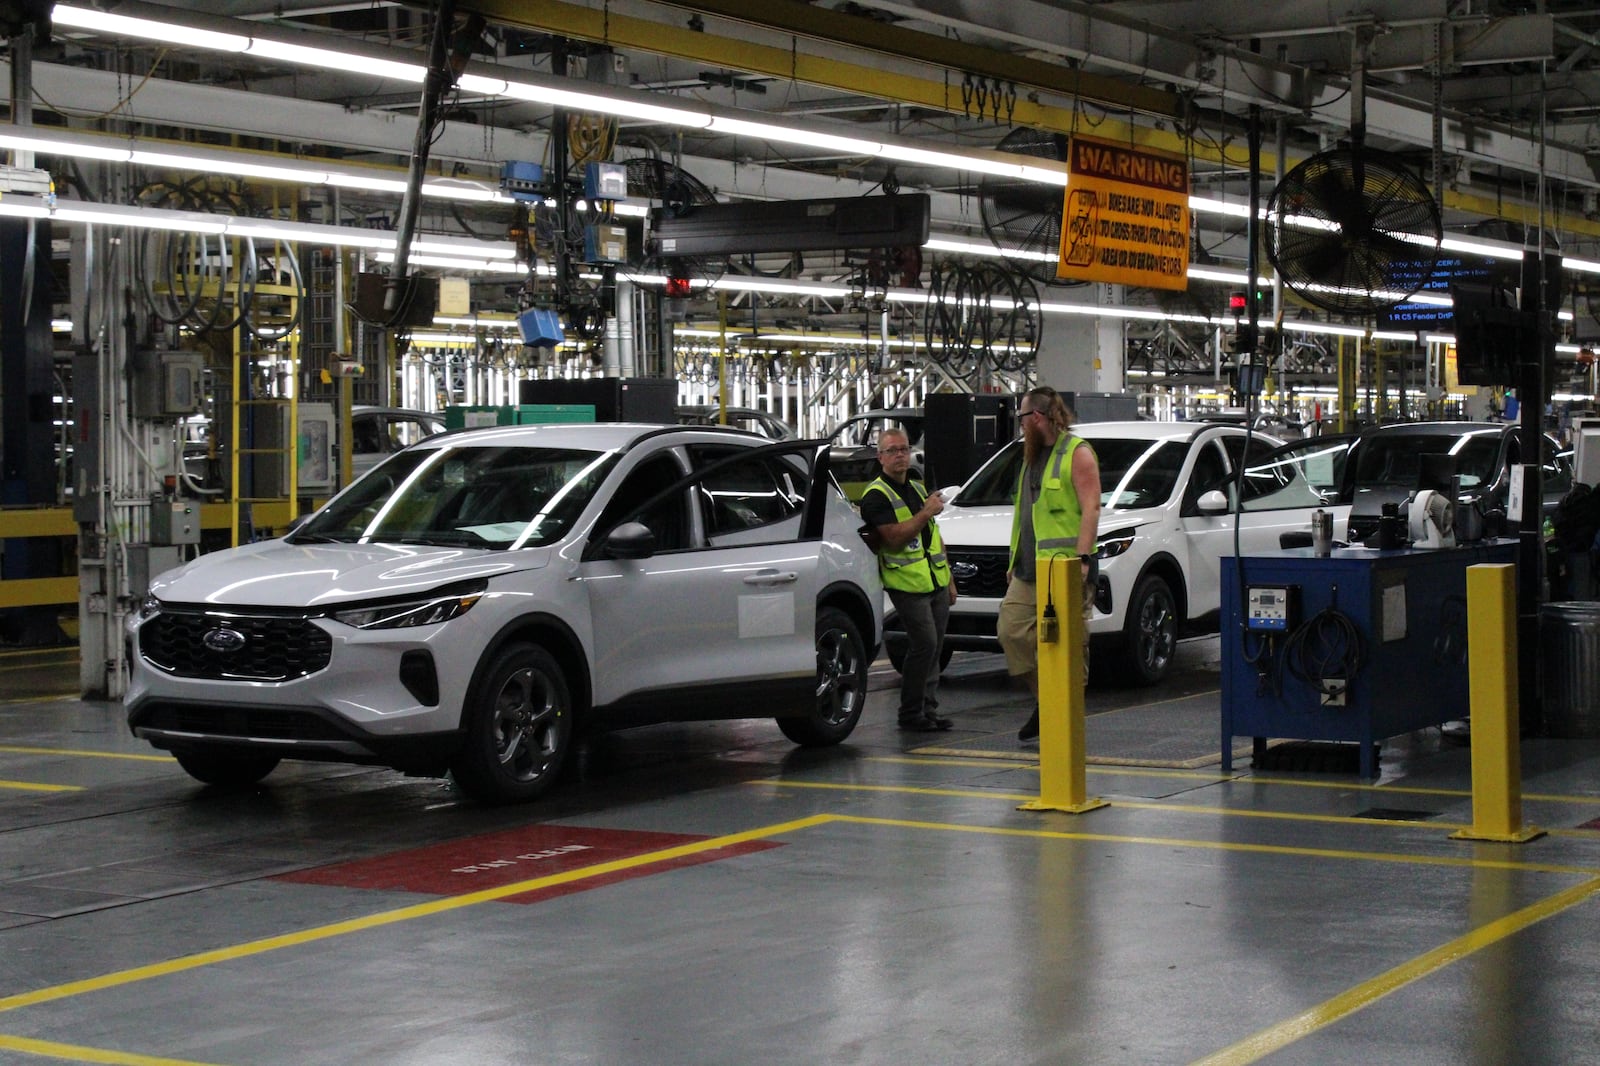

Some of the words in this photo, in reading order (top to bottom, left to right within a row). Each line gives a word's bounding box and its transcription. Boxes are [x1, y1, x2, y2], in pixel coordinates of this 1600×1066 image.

[1078, 146, 1183, 188] WARNING
[1127, 197, 1140, 215] ARE
[1142, 199, 1154, 217] NOT
[1156, 202, 1181, 222] ALLOWED
[1100, 220, 1110, 237] TO
[1149, 227, 1185, 249] PRODUCTION
[1146, 254, 1182, 274] CONVEYORS
